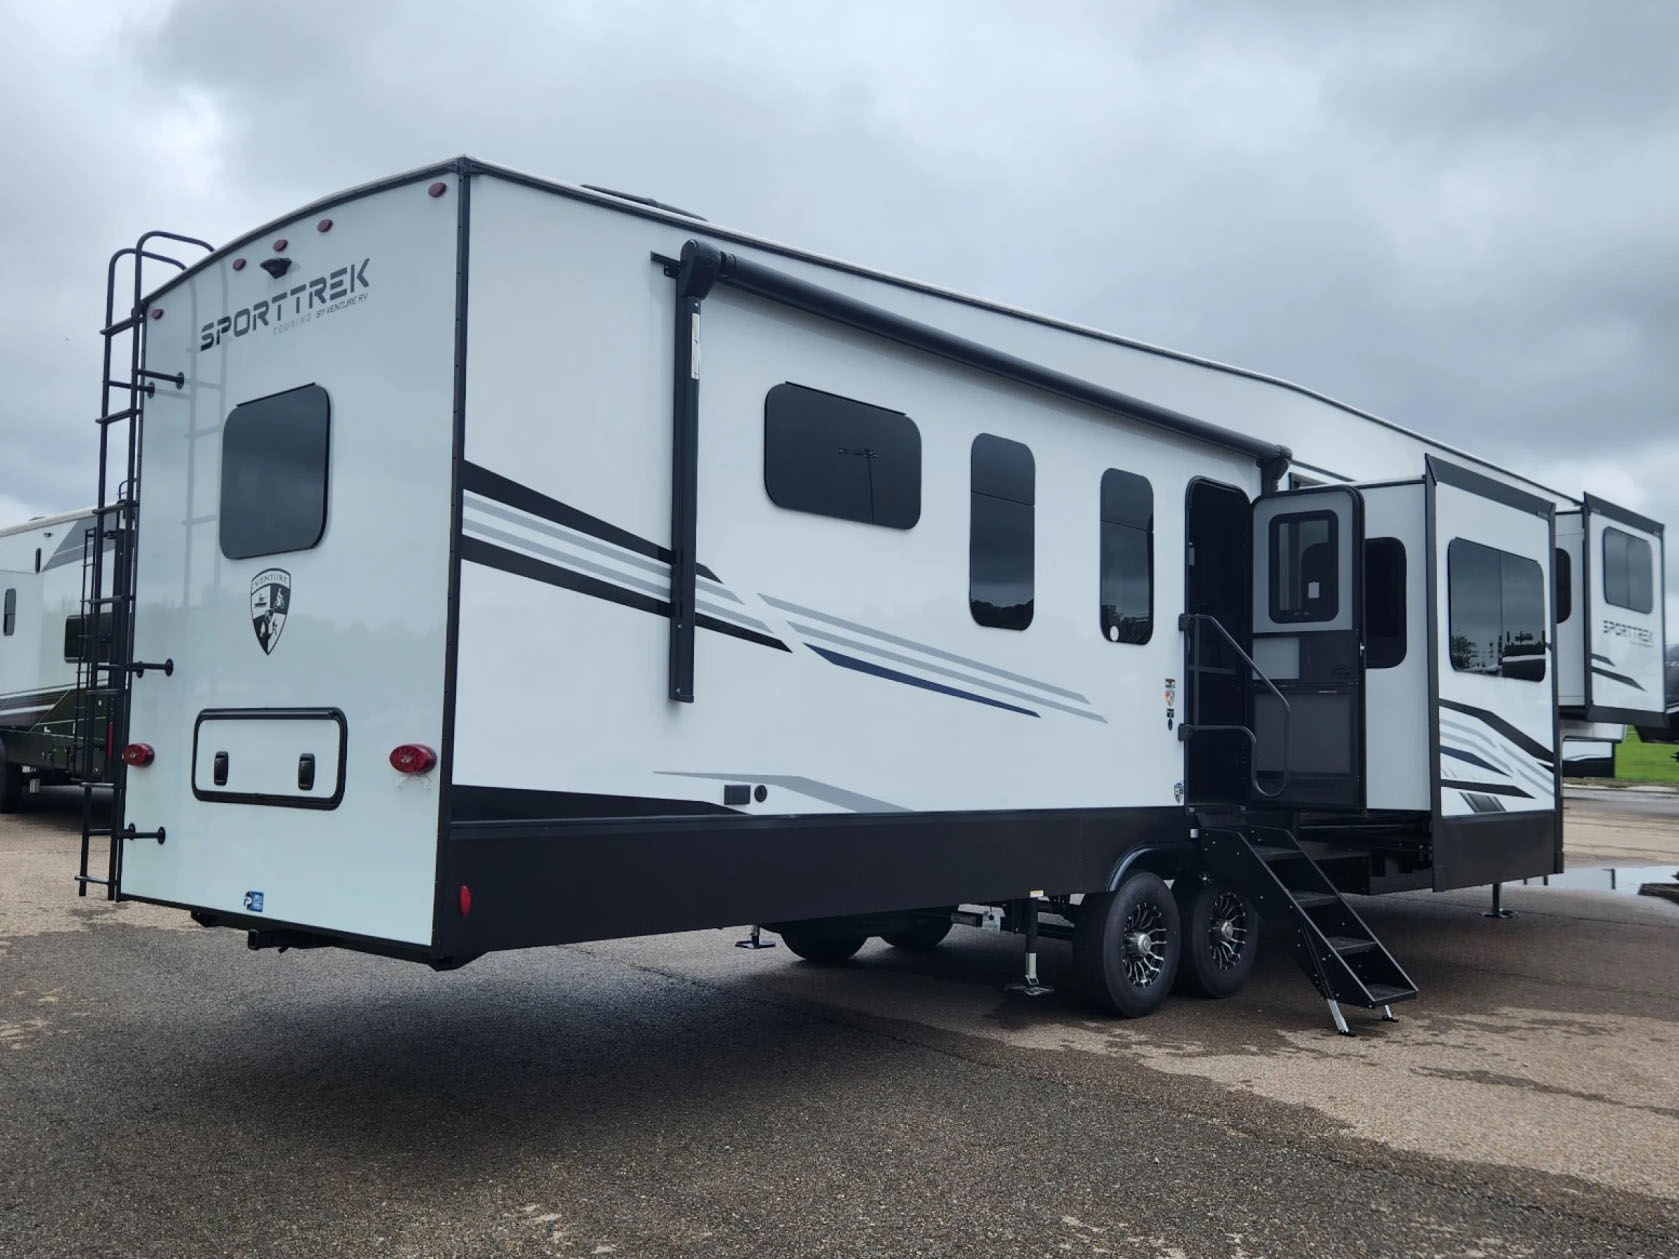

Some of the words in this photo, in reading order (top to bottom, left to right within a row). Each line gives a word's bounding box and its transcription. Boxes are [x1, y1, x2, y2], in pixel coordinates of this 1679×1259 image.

[201, 257, 370, 352] SPORTTREK
[326, 295, 357, 314] VENTURE
[254, 573, 288, 587] VENTURE
[1603, 619, 1654, 642] SPORTTREK
